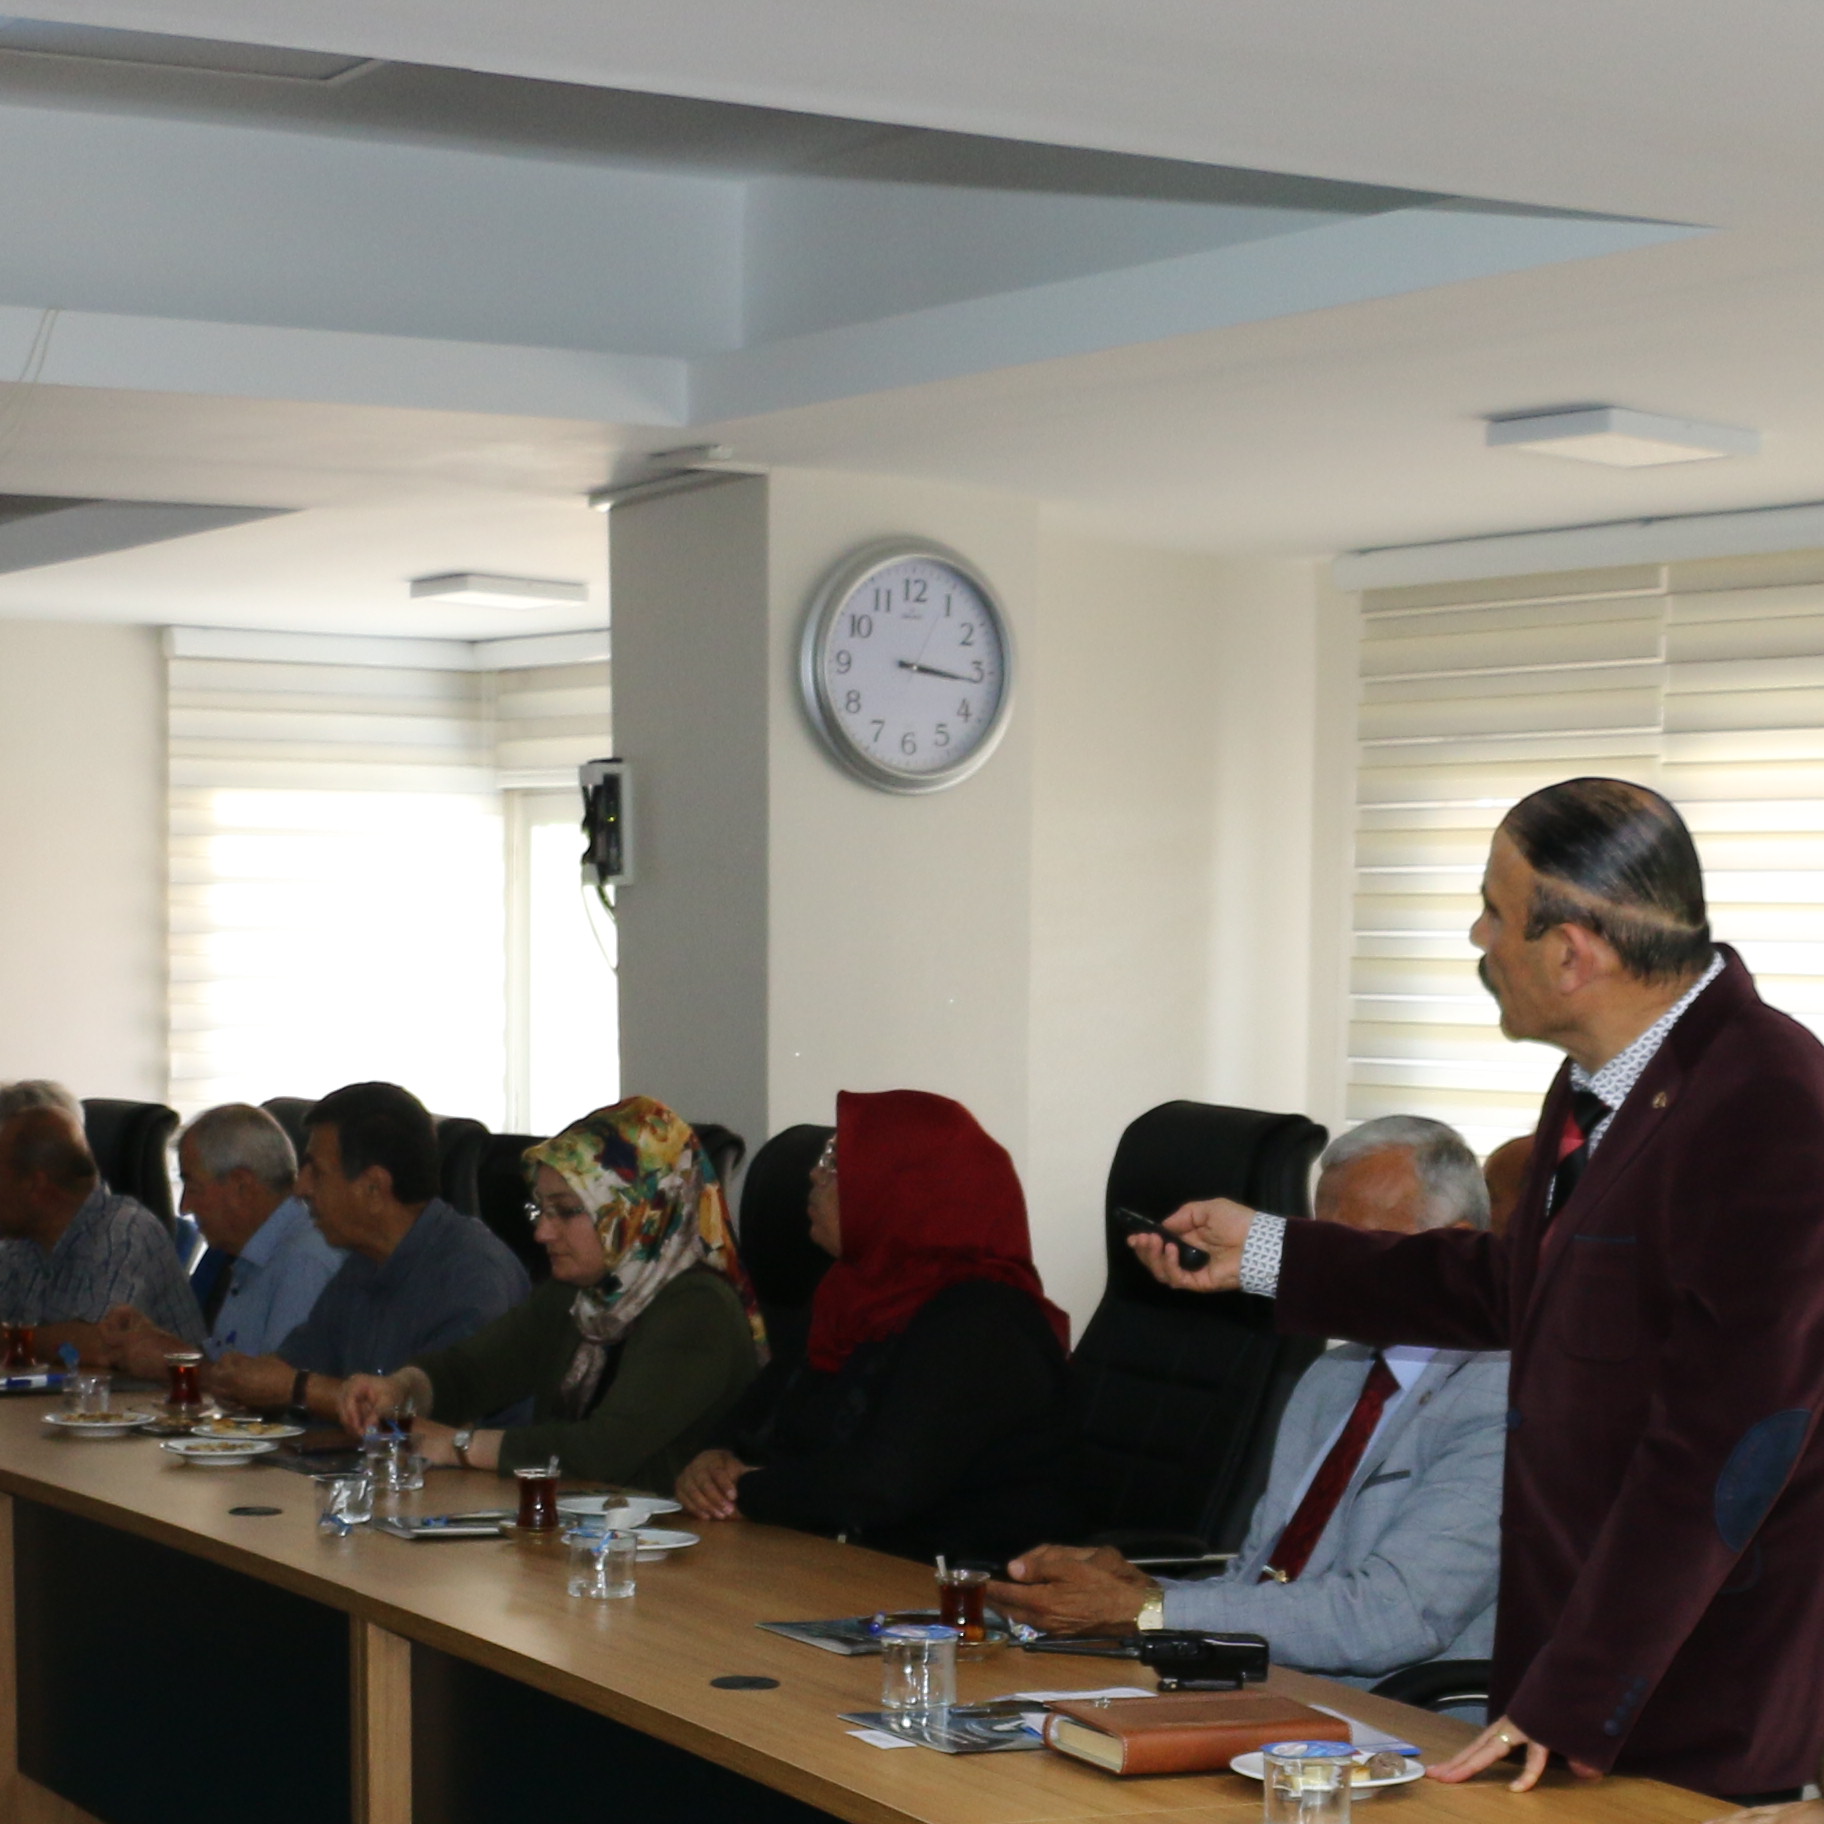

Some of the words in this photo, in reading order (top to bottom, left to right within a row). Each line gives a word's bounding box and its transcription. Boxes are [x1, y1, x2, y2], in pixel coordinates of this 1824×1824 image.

[874, 589, 892, 612] 11
[904, 579, 927, 602] 12
[850, 614, 872, 638] 10
[960, 623, 973, 645] 2
[836, 650, 852, 673] 9
[972, 661, 984, 683] 3
[846, 690, 861, 713] 8
[957, 698, 971, 722] 4
[870, 720, 884, 742] 7
[935, 724, 949, 746] 5
[901, 732, 916, 755] 6
